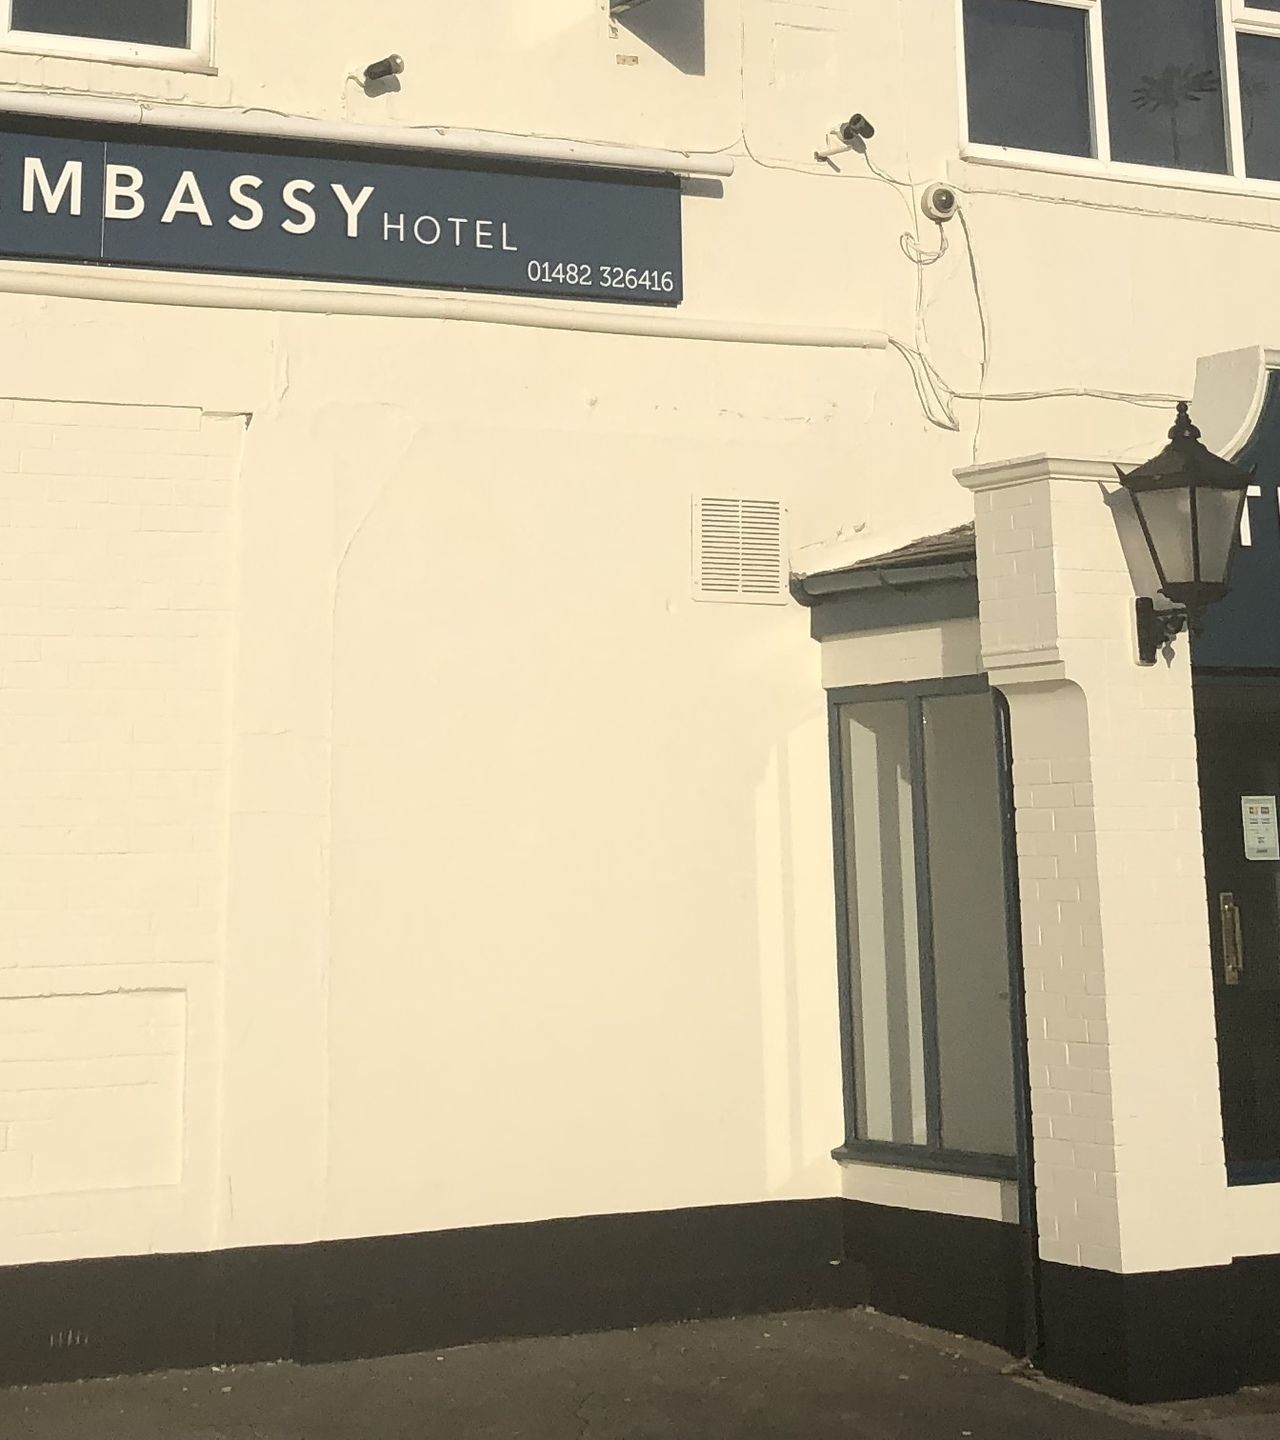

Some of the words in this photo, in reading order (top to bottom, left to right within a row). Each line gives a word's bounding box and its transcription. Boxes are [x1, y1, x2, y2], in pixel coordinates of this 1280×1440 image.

[382, 211, 518, 252] HOTEL
[527, 260, 592, 286] 01482
[599, 265, 674, 292] 326416
